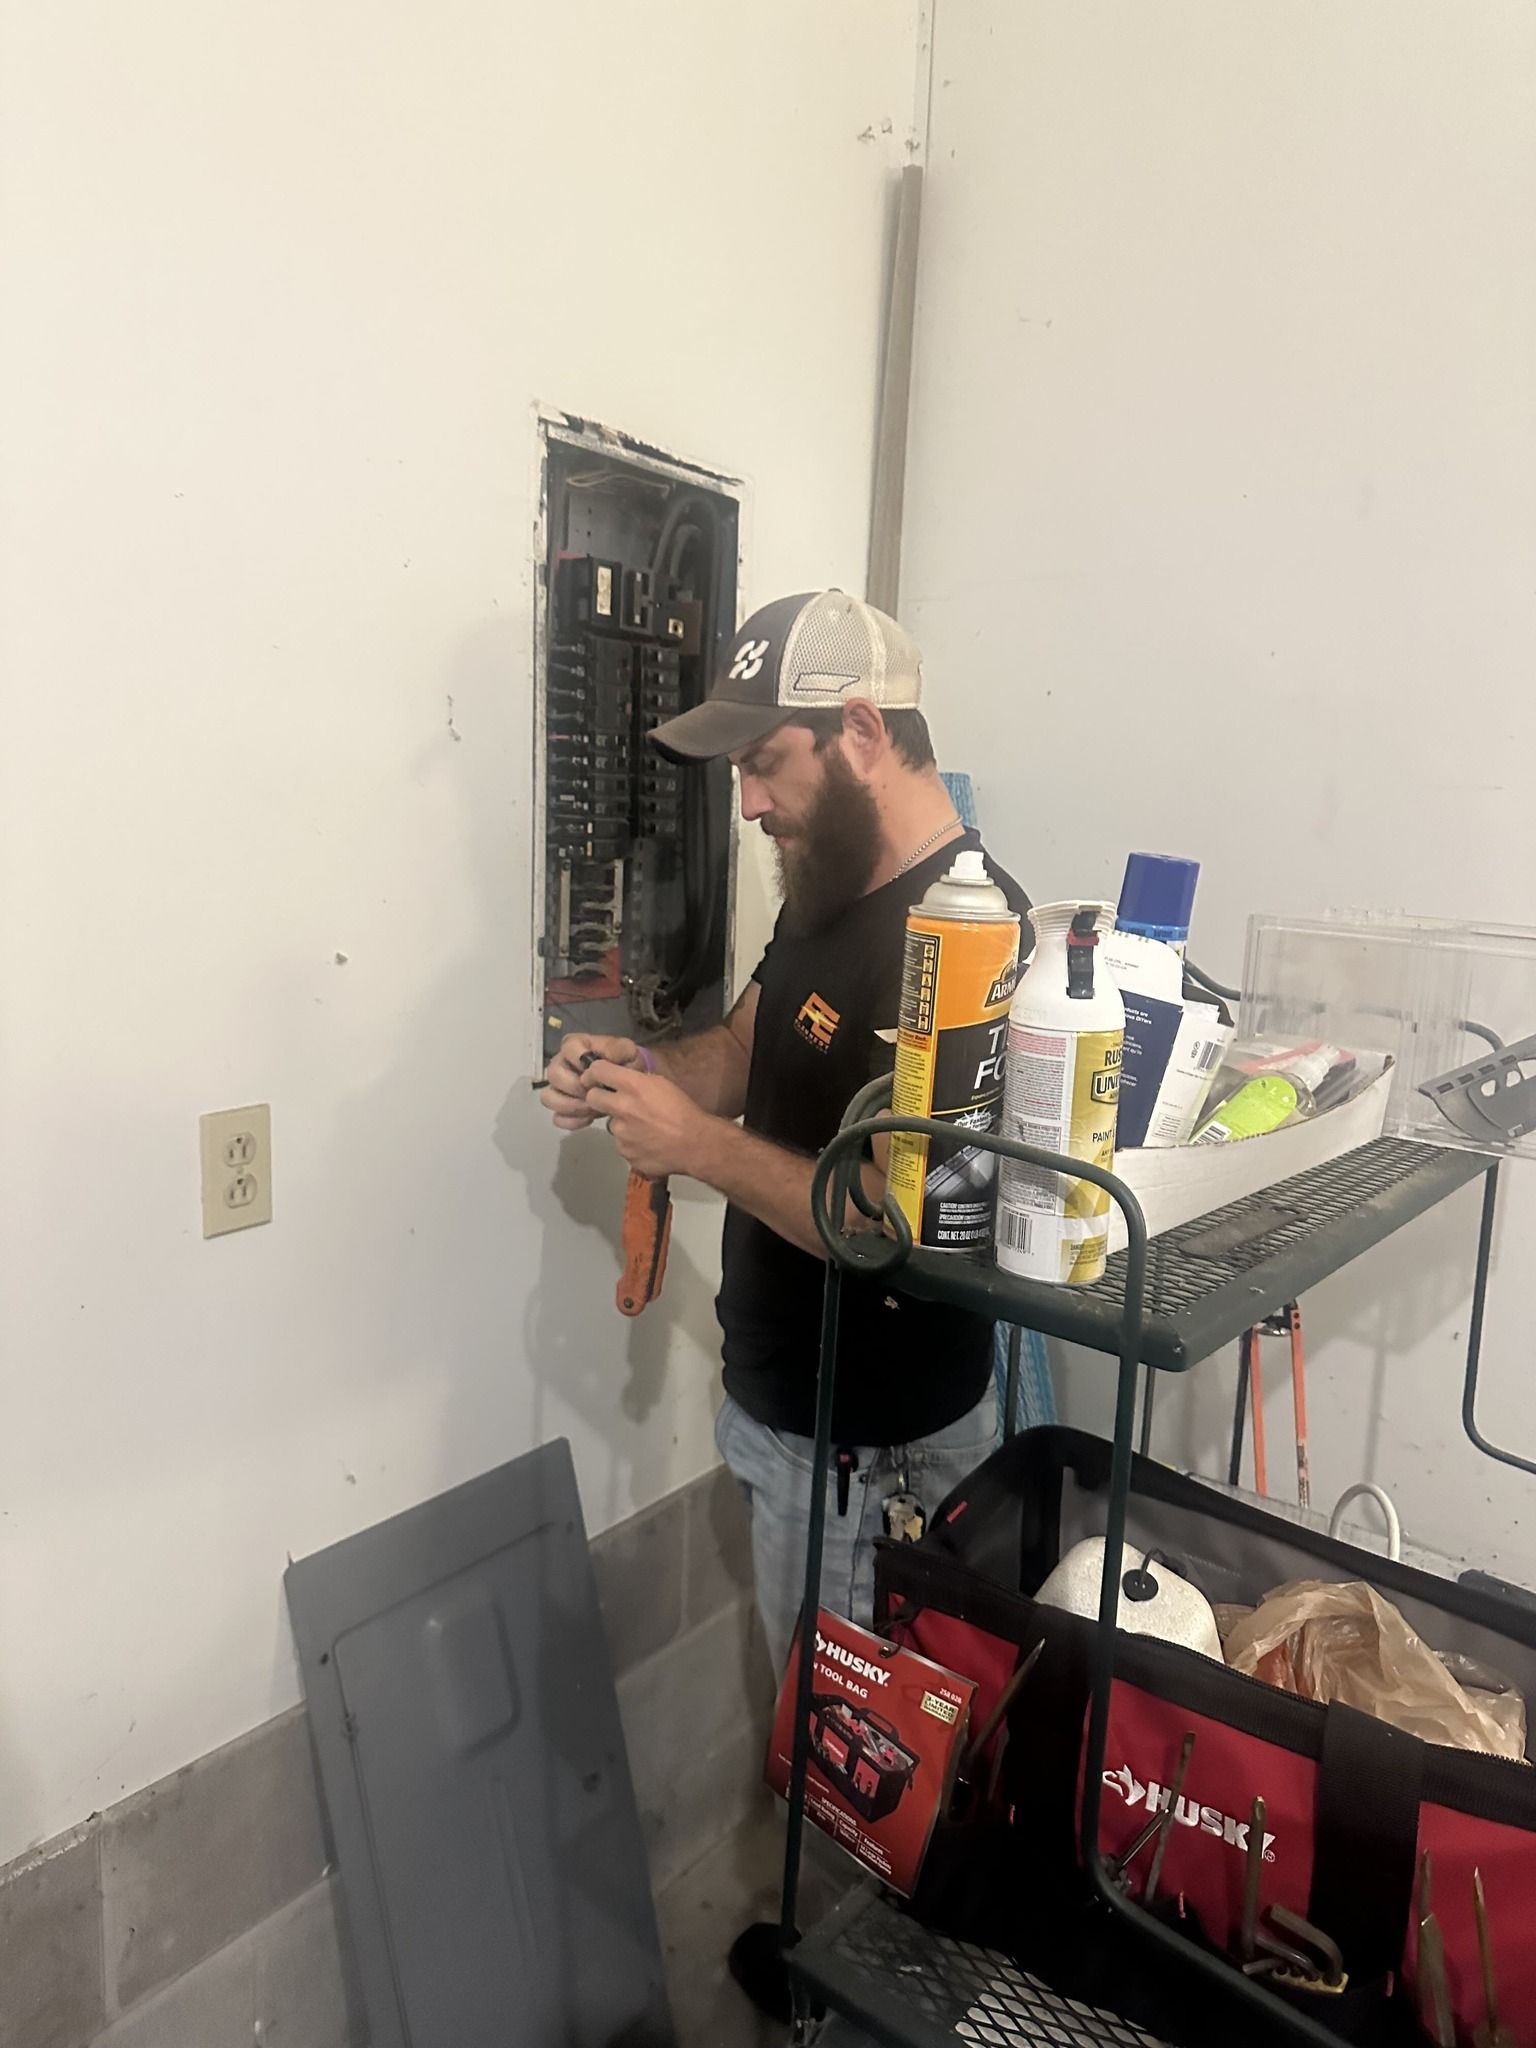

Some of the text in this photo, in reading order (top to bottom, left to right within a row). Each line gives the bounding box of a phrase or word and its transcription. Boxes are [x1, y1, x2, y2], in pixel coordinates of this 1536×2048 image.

[820, 1663, 844, 1686] TOOL
[846, 1679, 868, 1699] BAG
[826, 1640, 891, 1686] HUSKY
